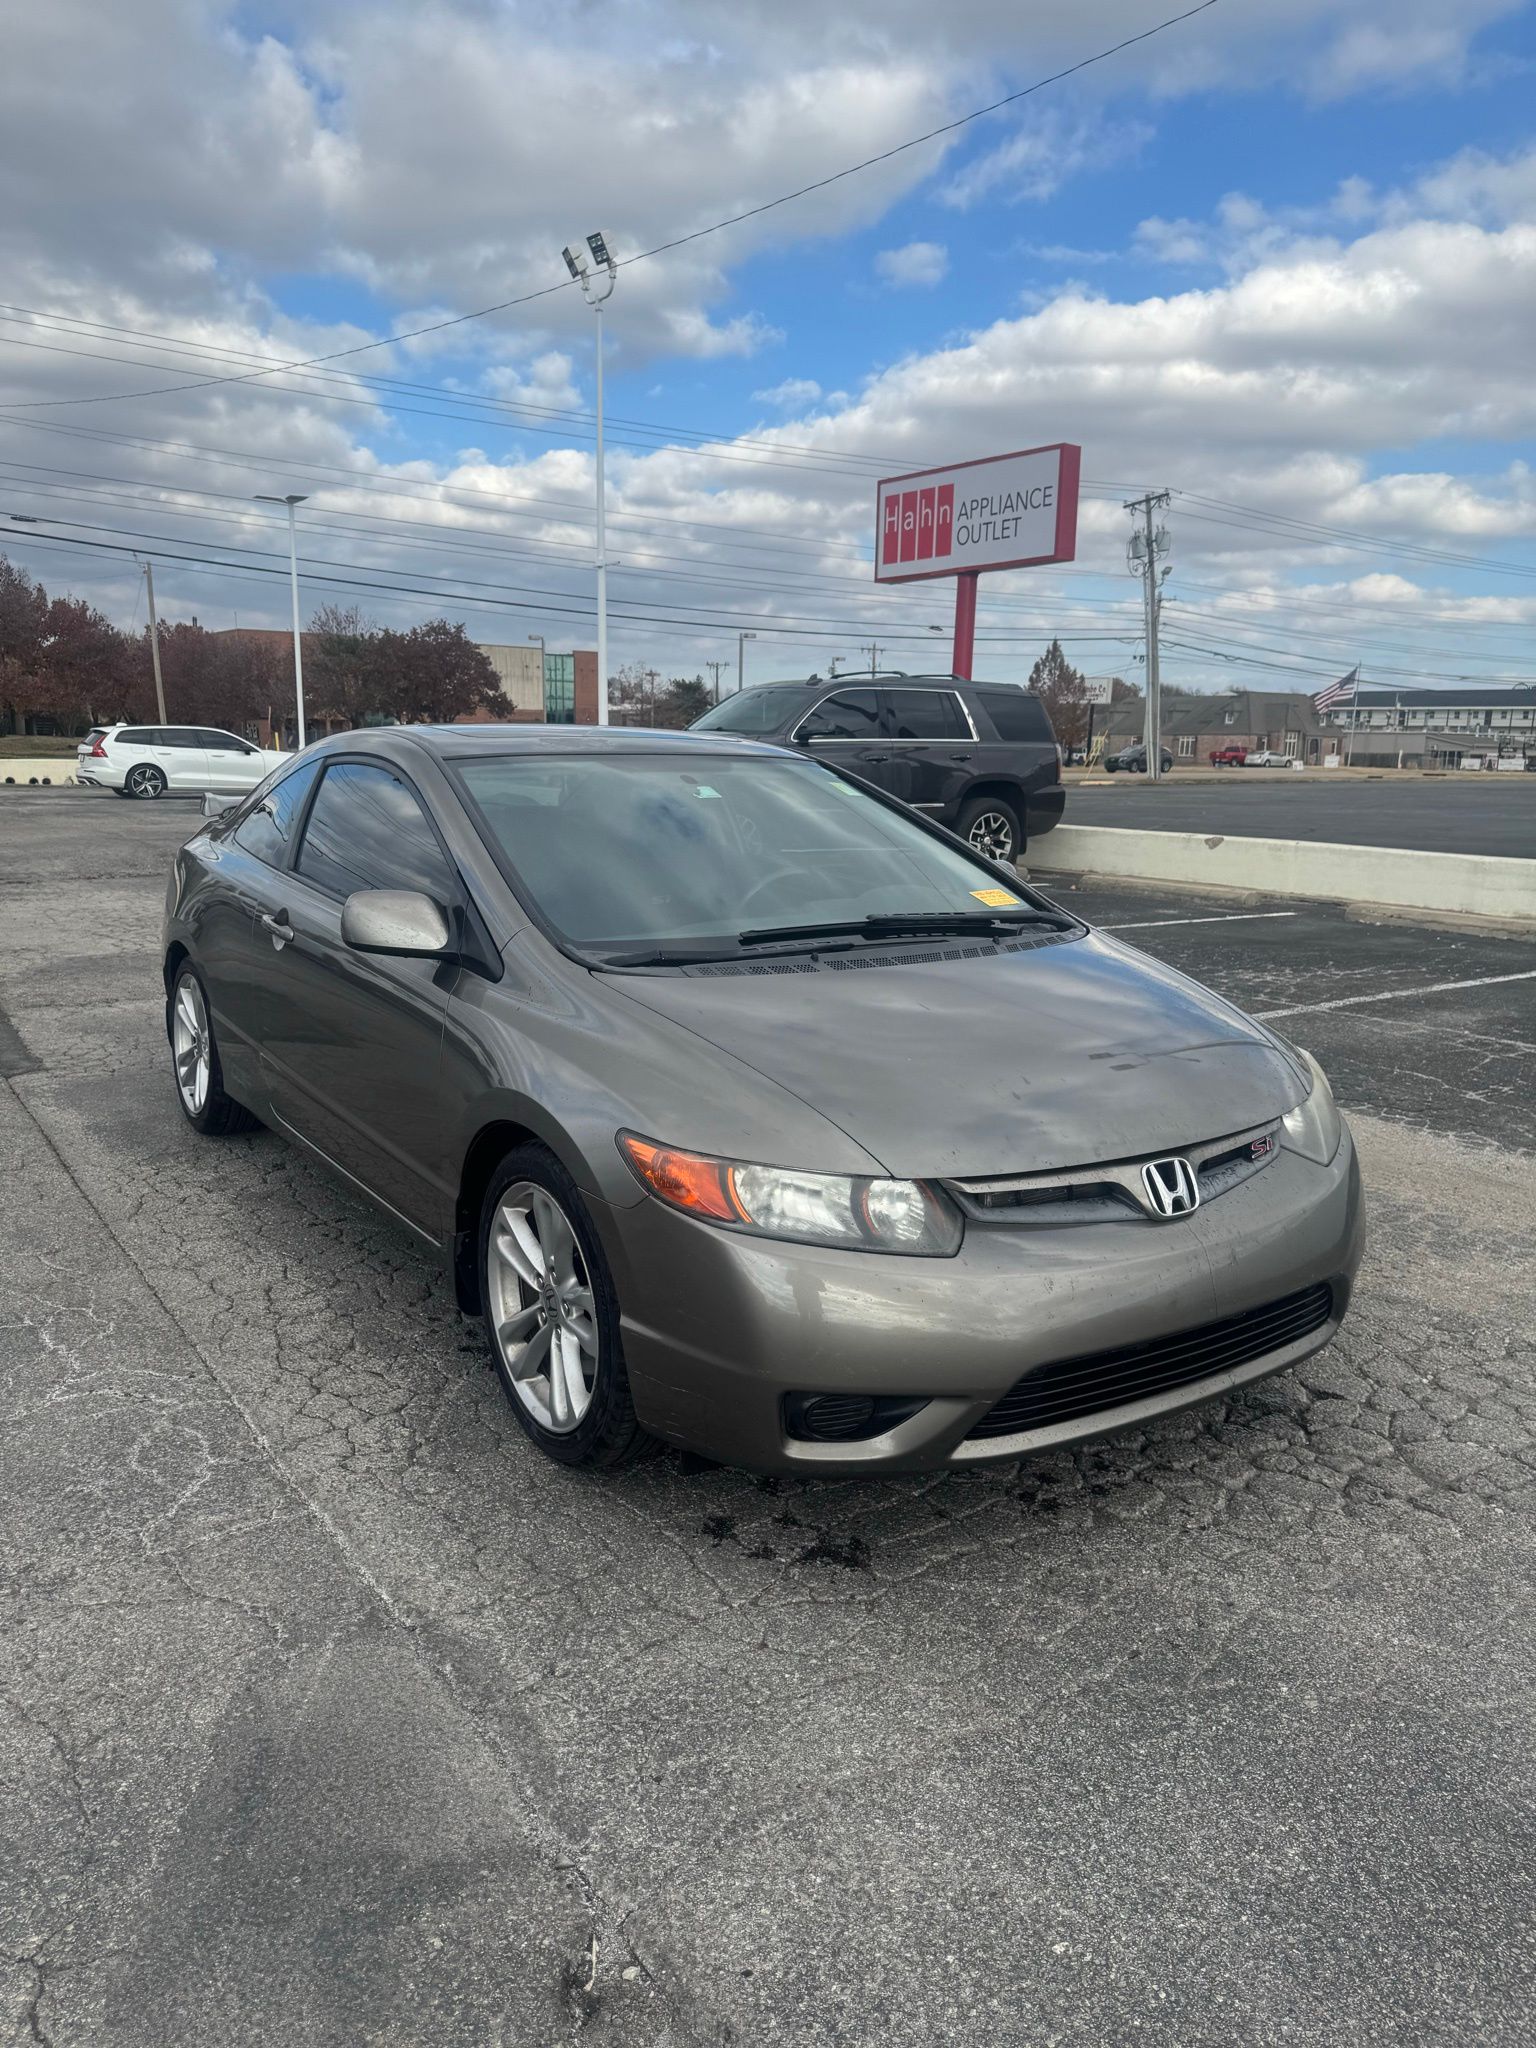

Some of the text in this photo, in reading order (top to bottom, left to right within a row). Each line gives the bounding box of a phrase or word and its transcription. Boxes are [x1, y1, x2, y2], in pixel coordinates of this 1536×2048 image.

[885, 499, 951, 534] Hahn
[957, 485, 1053, 522] APPLIANCE
[956, 517, 1022, 546] OUTLET
